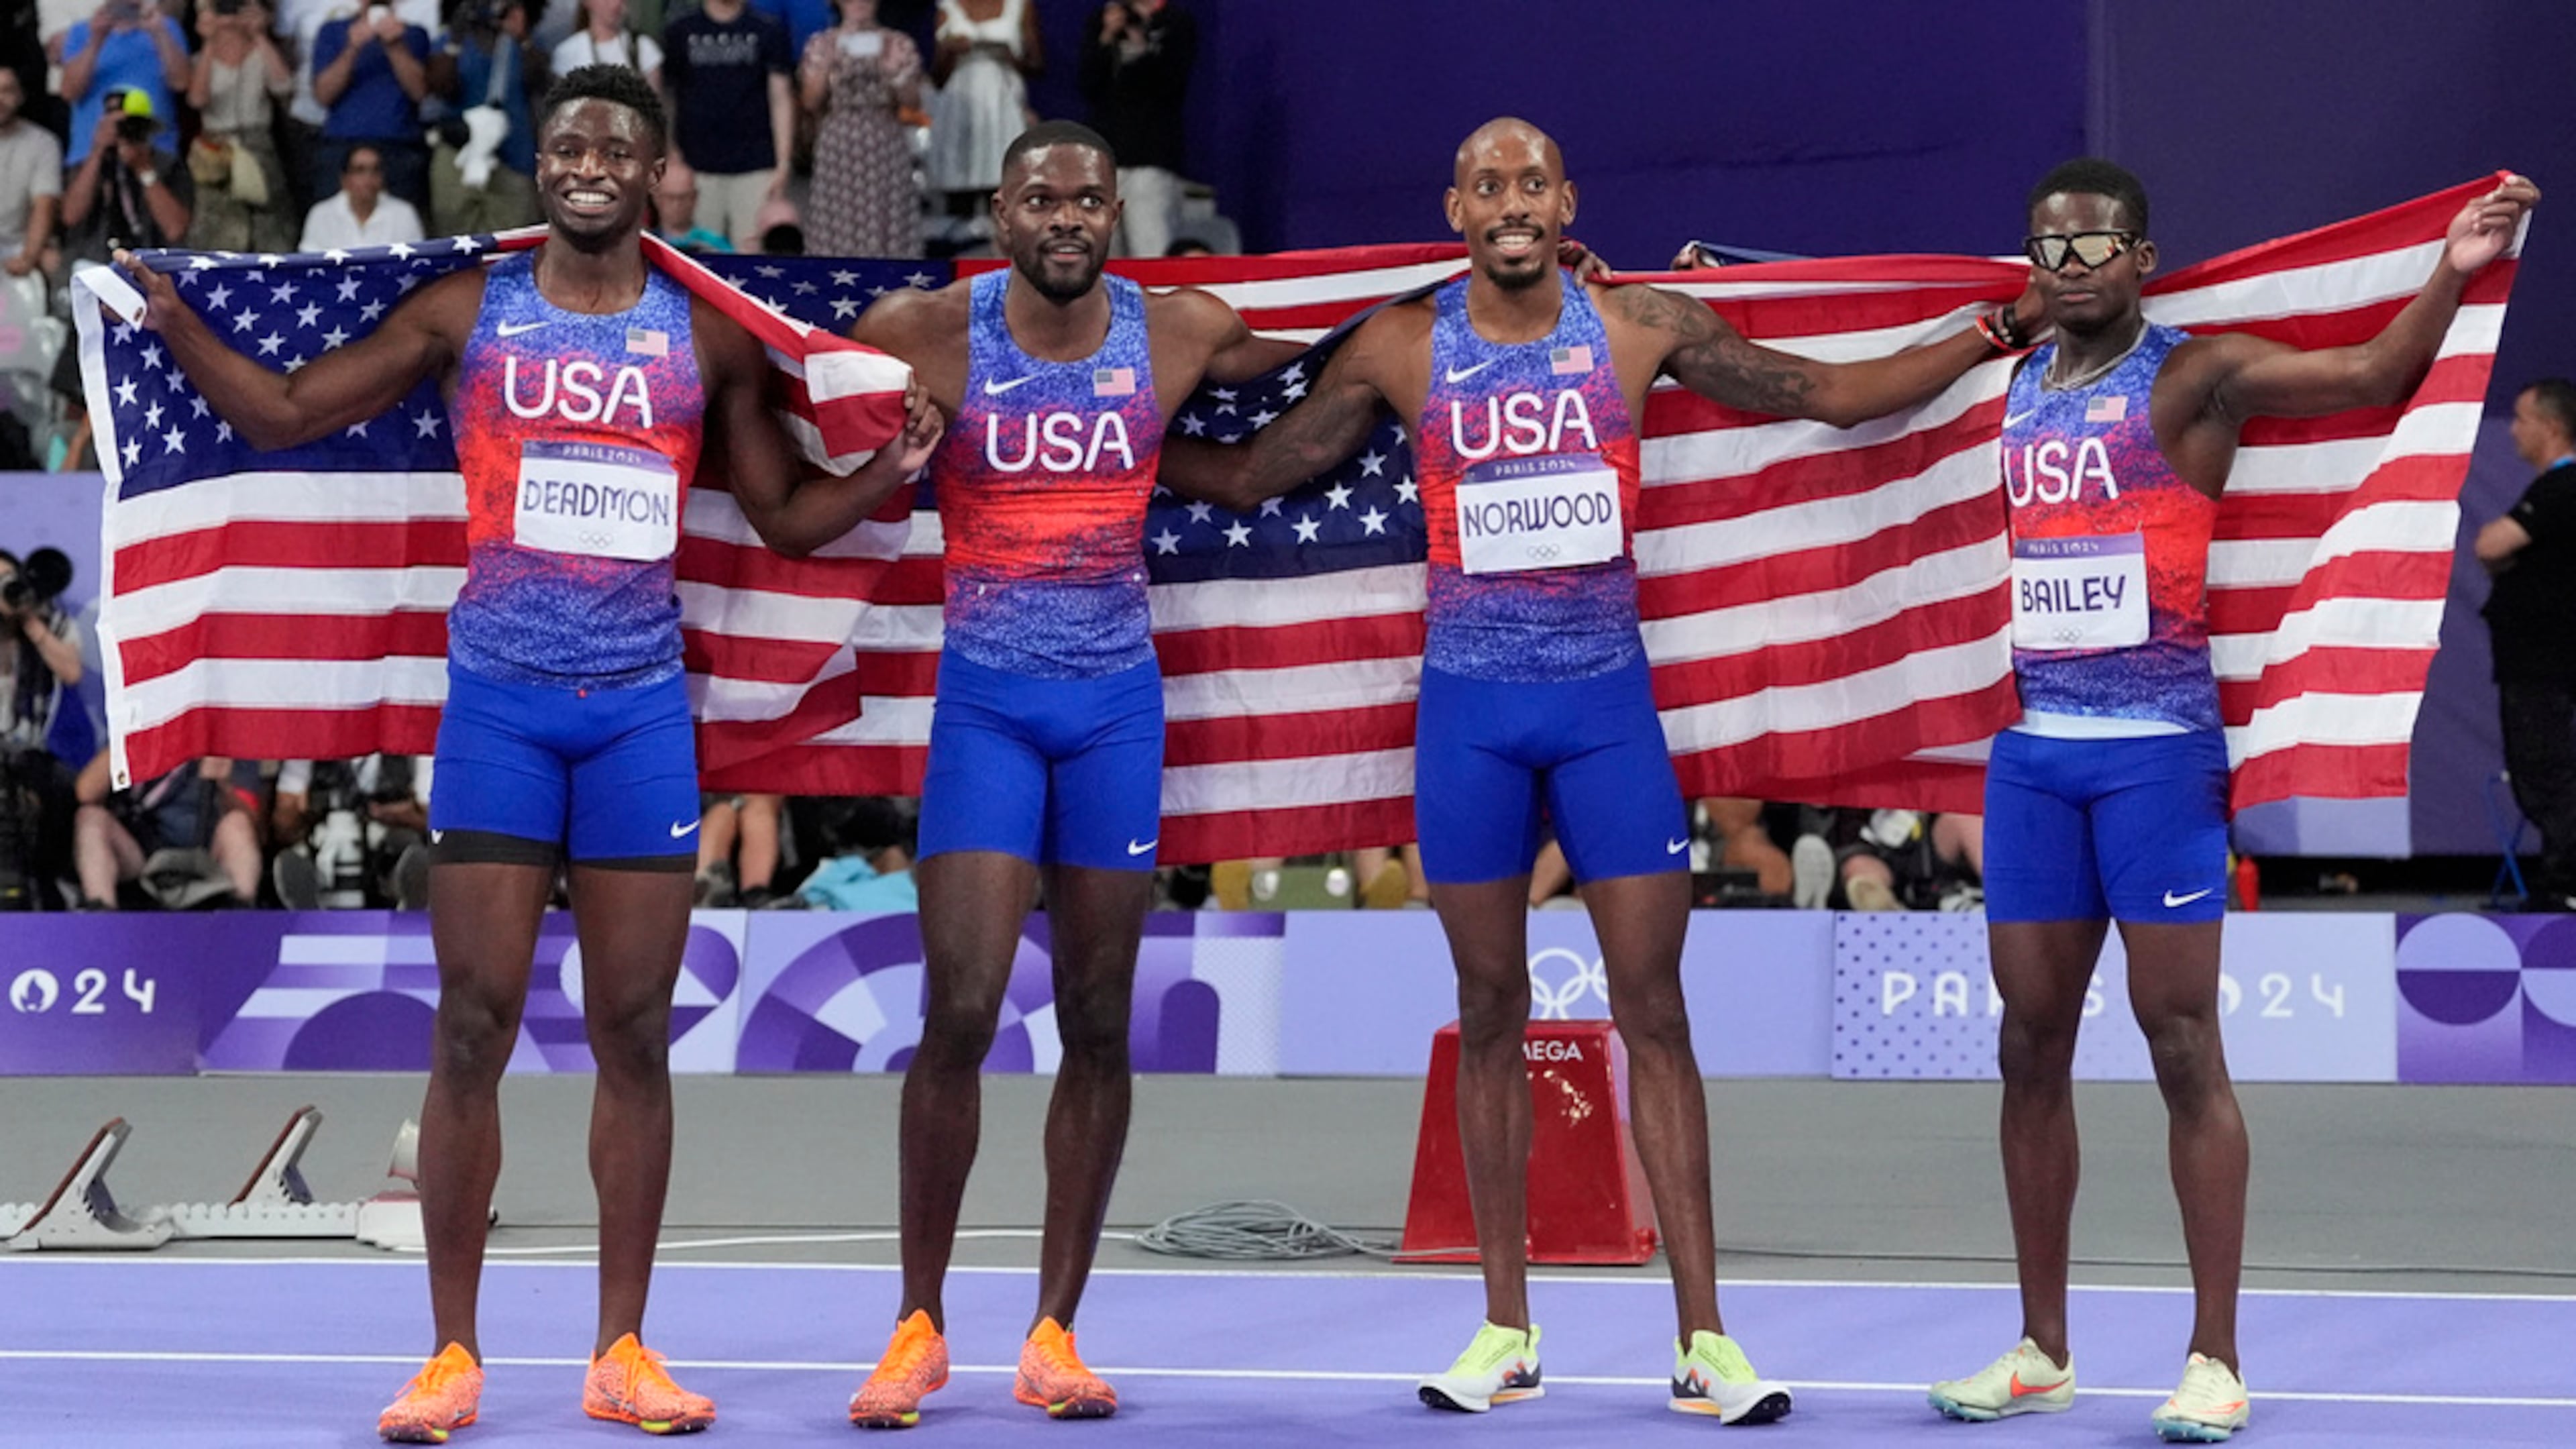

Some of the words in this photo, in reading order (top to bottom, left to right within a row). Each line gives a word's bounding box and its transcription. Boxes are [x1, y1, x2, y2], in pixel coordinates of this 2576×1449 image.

[504, 356, 653, 429] USA
[986, 411, 1134, 472] USA
[1451, 389, 1597, 459] USA
[563, 445, 603, 459] PARIS
[1495, 462, 1536, 477] PARIS
[2004, 437, 2119, 508] USA
[523, 479, 669, 526] DEADMON
[1464, 491, 1611, 537] NORWOOD
[2021, 574, 2126, 612] BAILEY
[1882, 971, 2105, 1017] PAS
[1523, 1040, 1583, 1062] EGA
